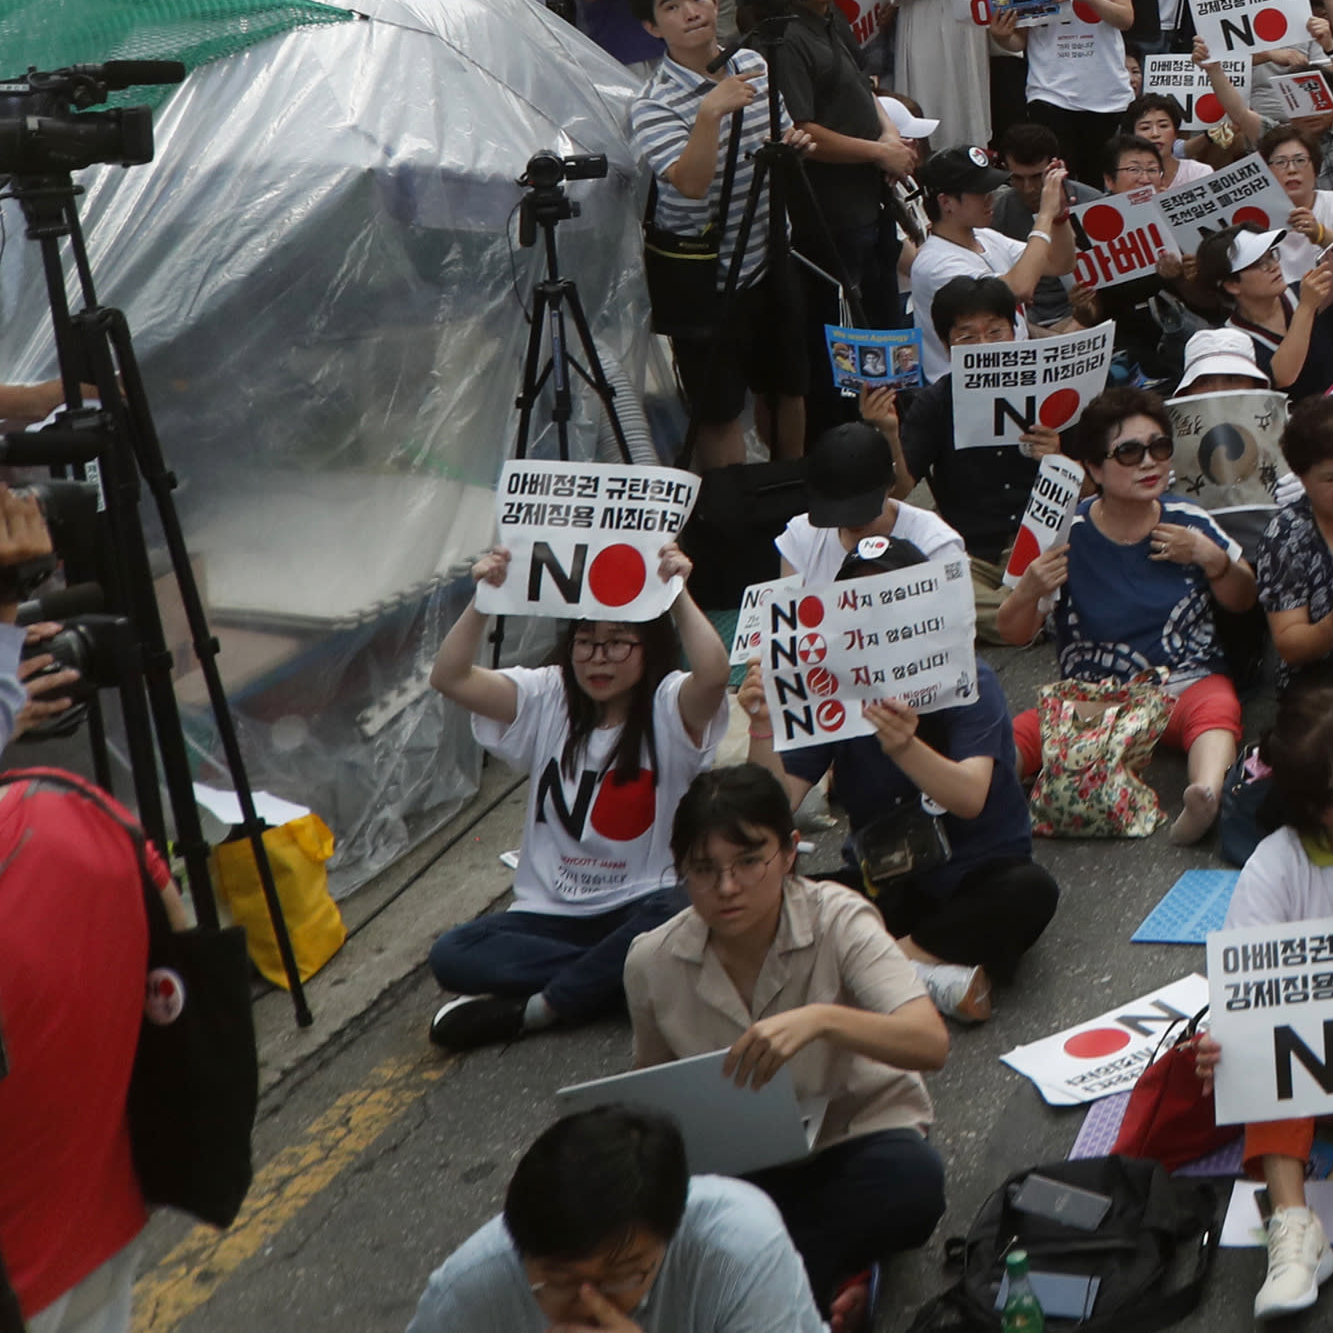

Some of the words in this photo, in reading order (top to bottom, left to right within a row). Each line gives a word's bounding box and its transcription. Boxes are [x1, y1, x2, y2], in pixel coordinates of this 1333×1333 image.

[963, 348, 1037, 370] 아베정권
[1042, 334, 1106, 361] 규탄한다
[963, 369, 1037, 390] 강제징용
[1042, 354, 1105, 383] 사죄하라
[508, 472, 598, 499] 아베정권
[605, 476, 691, 507] 규탄한다
[502, 503, 592, 528] 강제징용
[600, 505, 685, 533] 사죄하라
[880, 579, 939, 603] 않습니다!
[886, 617, 945, 643] 않습니다!
[892, 653, 949, 679] 않습니다!
